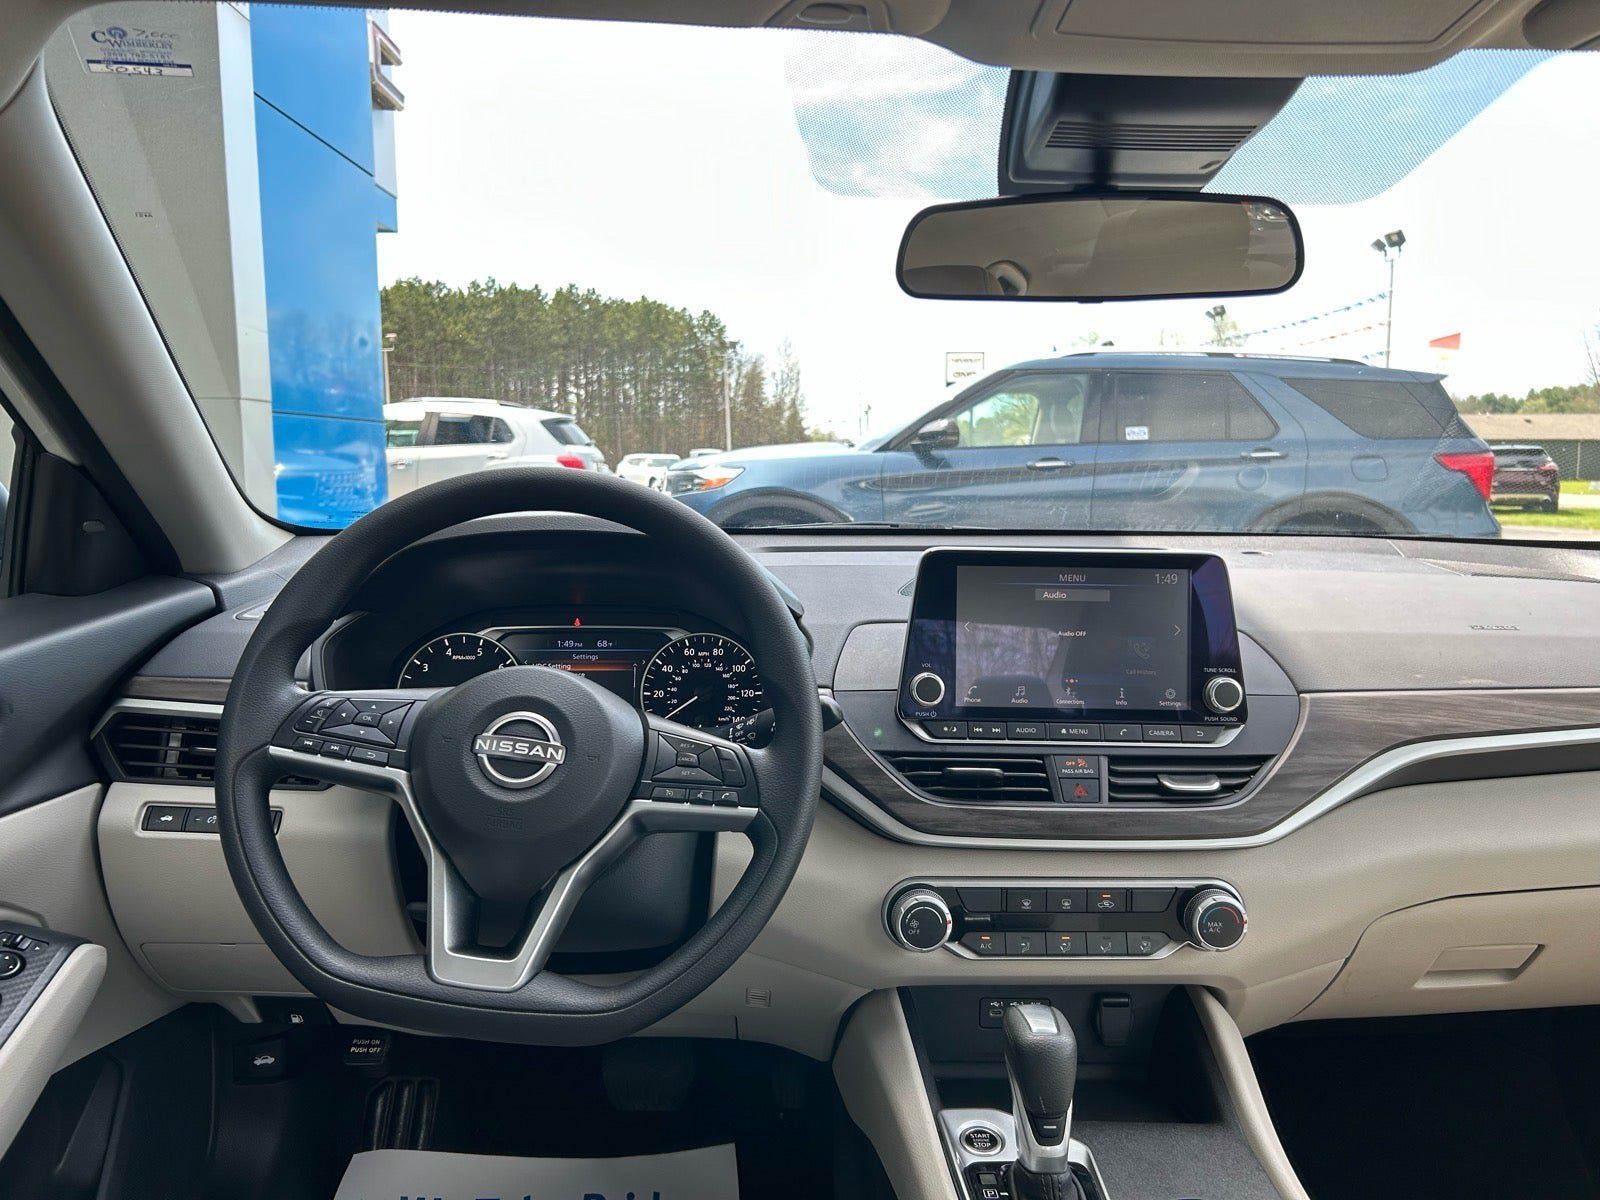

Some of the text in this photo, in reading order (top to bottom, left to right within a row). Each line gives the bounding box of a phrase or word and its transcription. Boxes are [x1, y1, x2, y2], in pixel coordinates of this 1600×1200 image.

[1155, 574, 1178, 584] 1:49
[446, 648, 452, 656] 4
[477, 648, 483, 656] 5
[422, 663, 428, 672] 3
[475, 739, 563, 760] NISSAN
